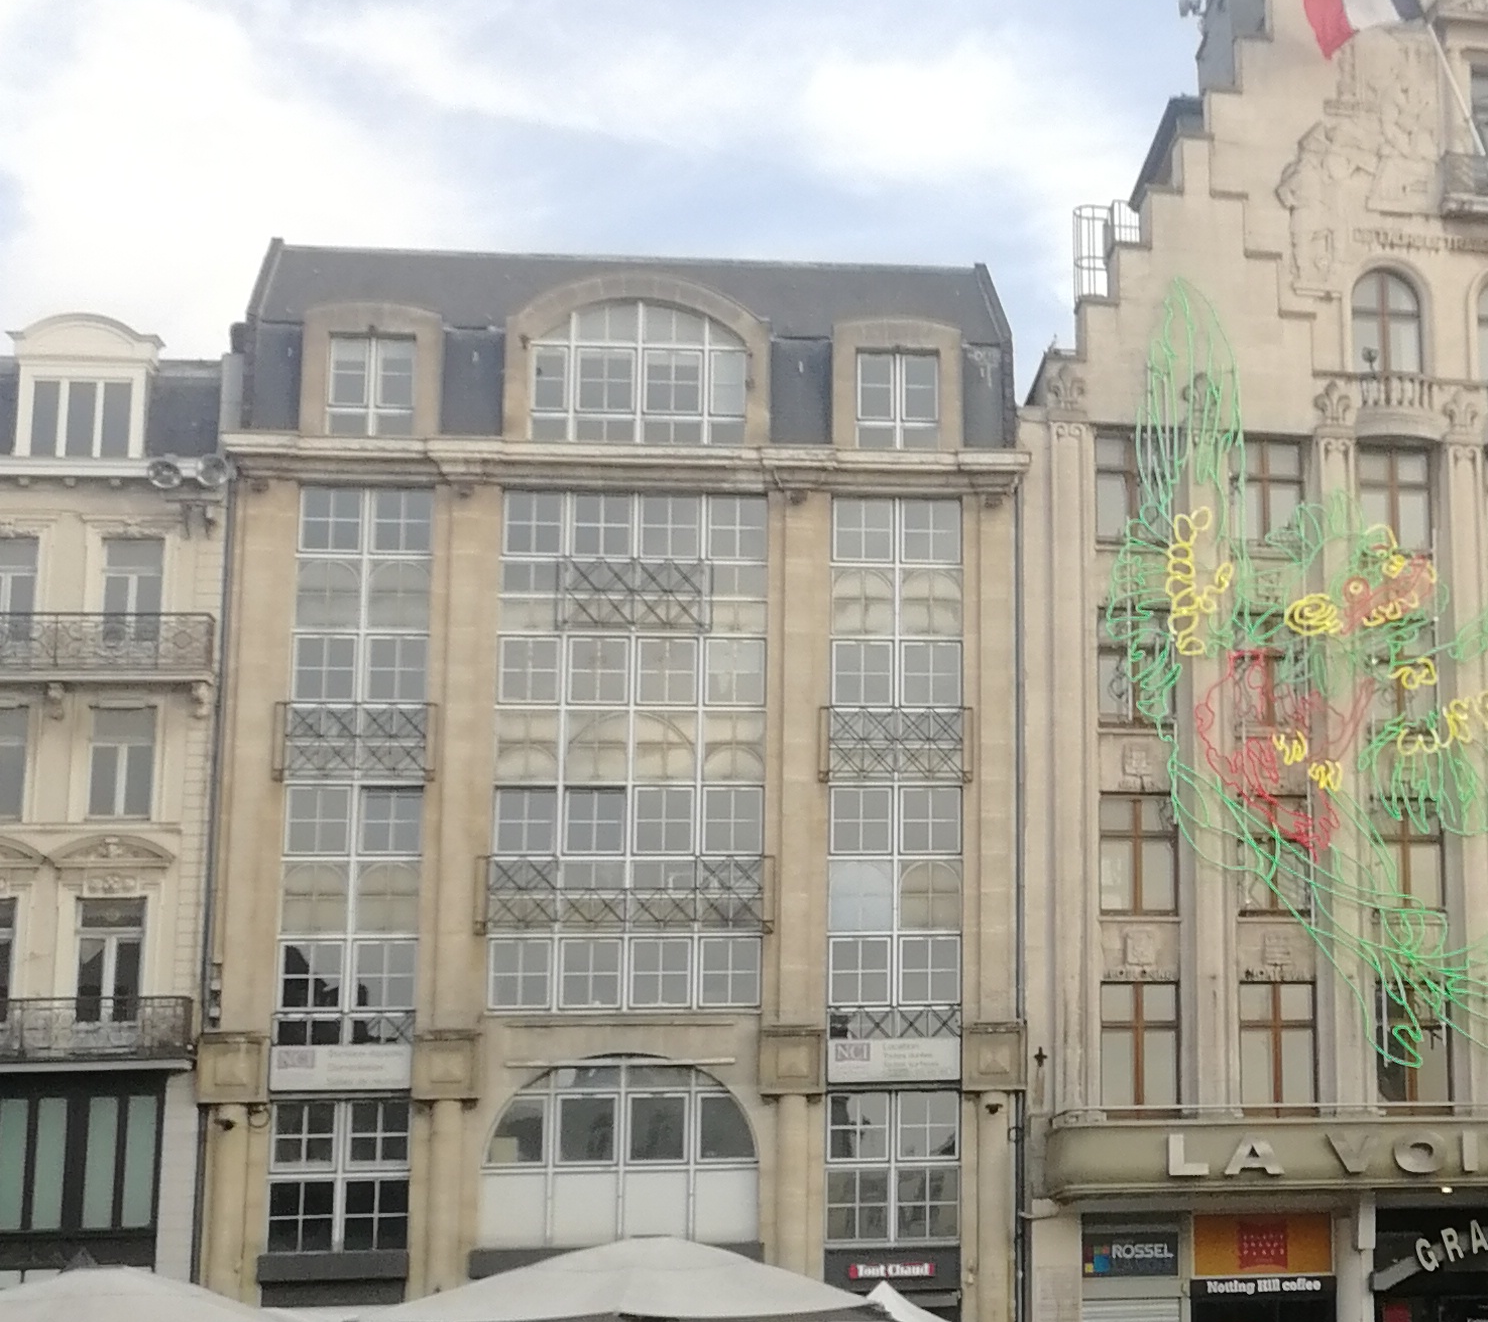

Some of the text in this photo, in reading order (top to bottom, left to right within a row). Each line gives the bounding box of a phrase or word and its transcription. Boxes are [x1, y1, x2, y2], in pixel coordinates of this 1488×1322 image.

[837, 1044, 869, 1060] NCI
[1167, 1132, 1285, 1176] LA
[1112, 1243, 1174, 1259] ROSSEL
[887, 1262, 929, 1277] Chaud
[1206, 1277, 1322, 1295] Notting Hill coffee
